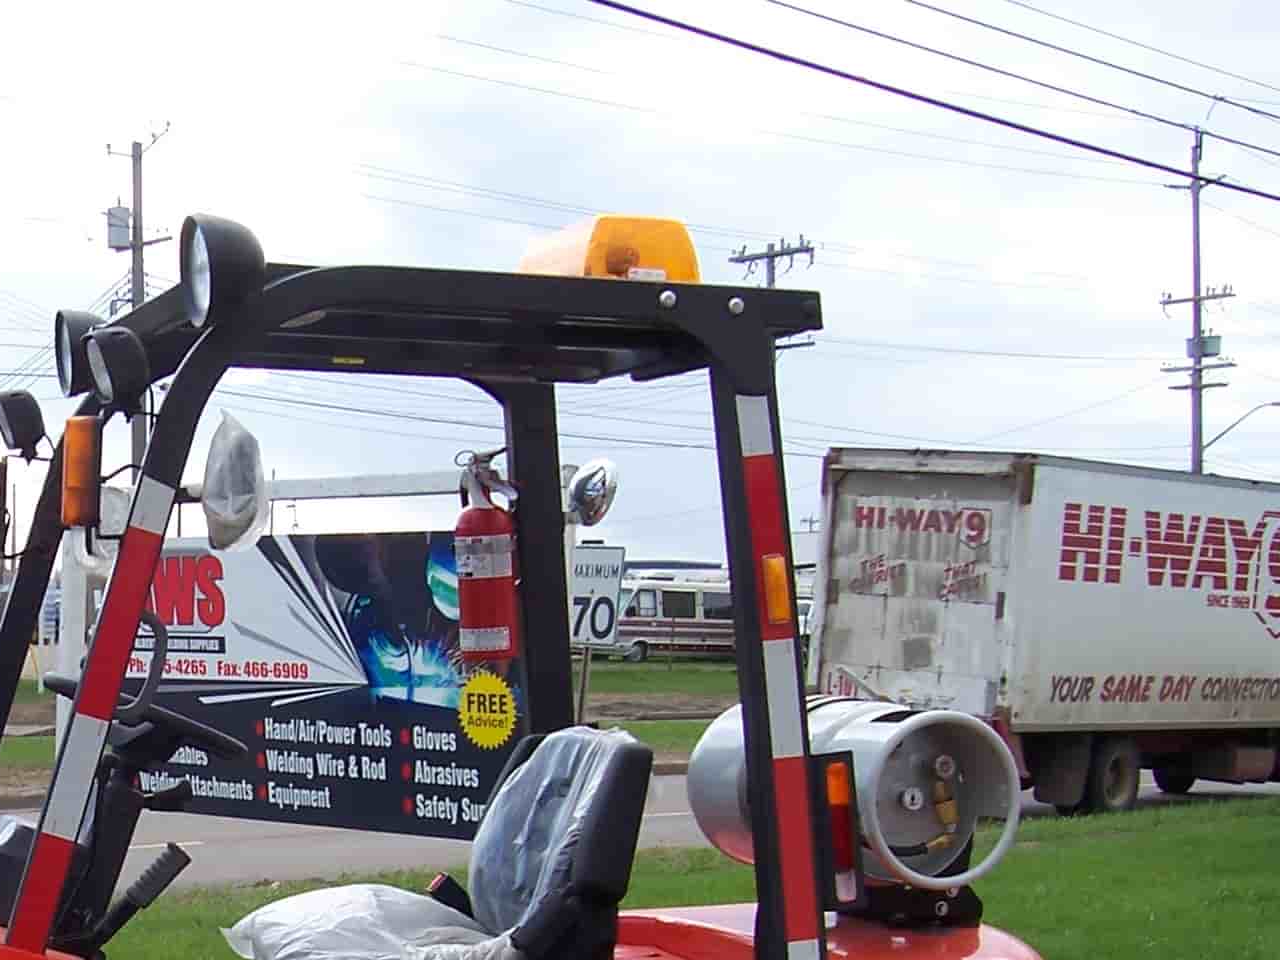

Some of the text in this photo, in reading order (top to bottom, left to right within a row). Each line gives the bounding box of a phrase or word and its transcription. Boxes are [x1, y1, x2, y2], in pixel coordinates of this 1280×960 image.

[855, 506, 961, 534] HI-WAY
[1058, 502, 1266, 592] HI-WAY
[572, 596, 616, 639] 70
[164, 659, 207, 675] 5-4265
[243, 662, 309, 679] 466-6909
[467, 693, 507, 714] FREE
[1049, 675, 1095, 704] YOUR
[1099, 675, 1154, 703] SAME
[1159, 676, 1196, 702] DAY
[264, 717, 392, 748] Hand/Air/Power Tools
[468, 716, 509, 729] Advice!
[413, 725, 457, 752] Gloves
[266, 748, 387, 781] Welding Wire & Rod
[414, 759, 479, 788] Abrasives
[186, 773, 254, 801] ttachments
[268, 781, 331, 810] Equipment
[416, 793, 459, 824] Safety
